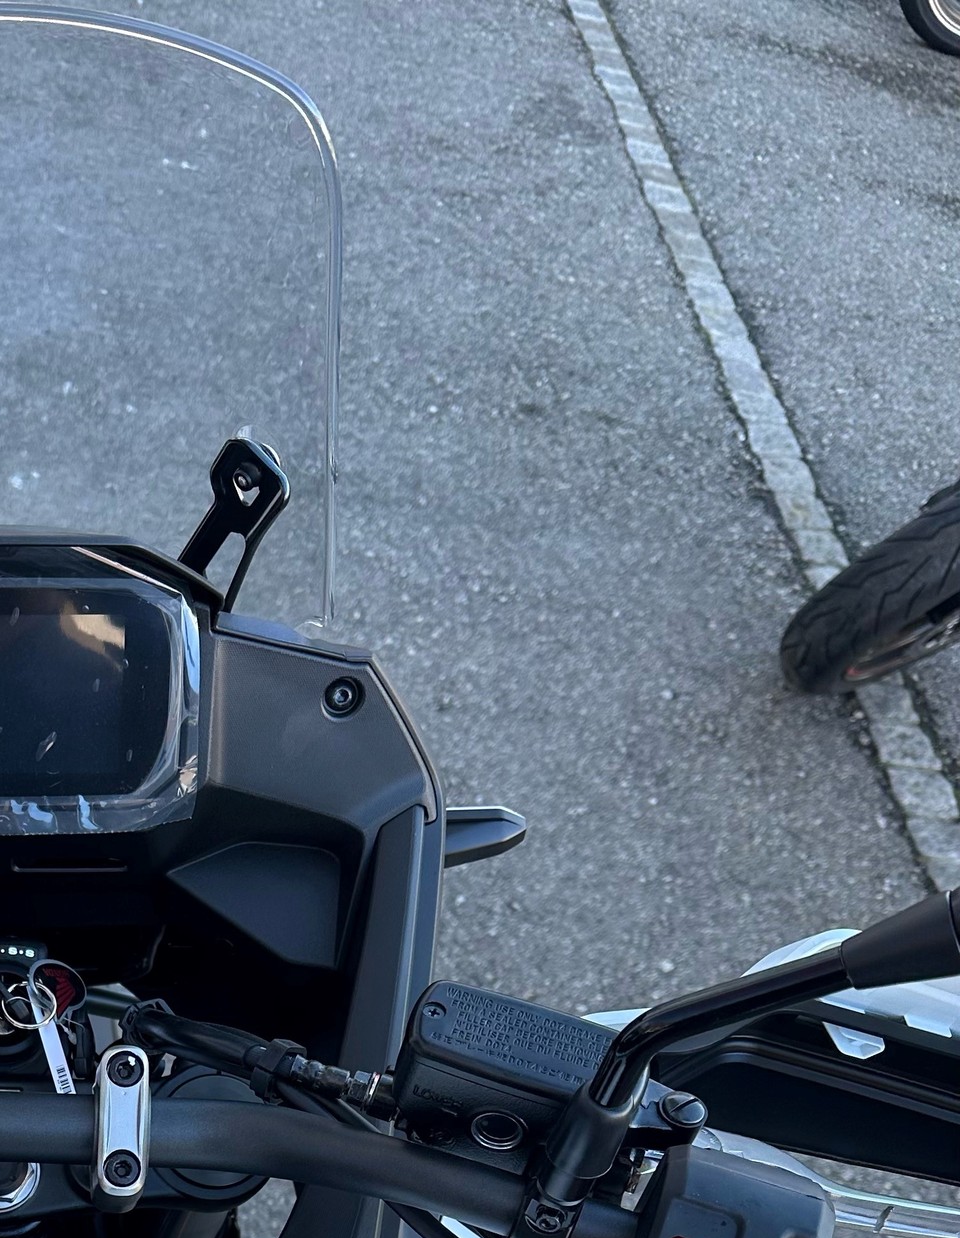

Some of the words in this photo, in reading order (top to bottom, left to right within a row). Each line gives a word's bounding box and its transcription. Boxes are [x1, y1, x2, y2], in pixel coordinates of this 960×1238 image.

[447, 987, 494, 1008] WARNING
[495, 1003, 515, 1016] USE
[517, 1010, 541, 1023] ONLY
[569, 1025, 602, 1043] BRAKE
[450, 1028, 482, 1043] FREIN
[451, 999, 479, 1014] FROM
[488, 1011, 528, 1029] SEALED
[588, 1041, 609, 1054] CLE
[456, 1010, 492, 1028] FILLER
[515, 1028, 554, 1047] BEFORE
